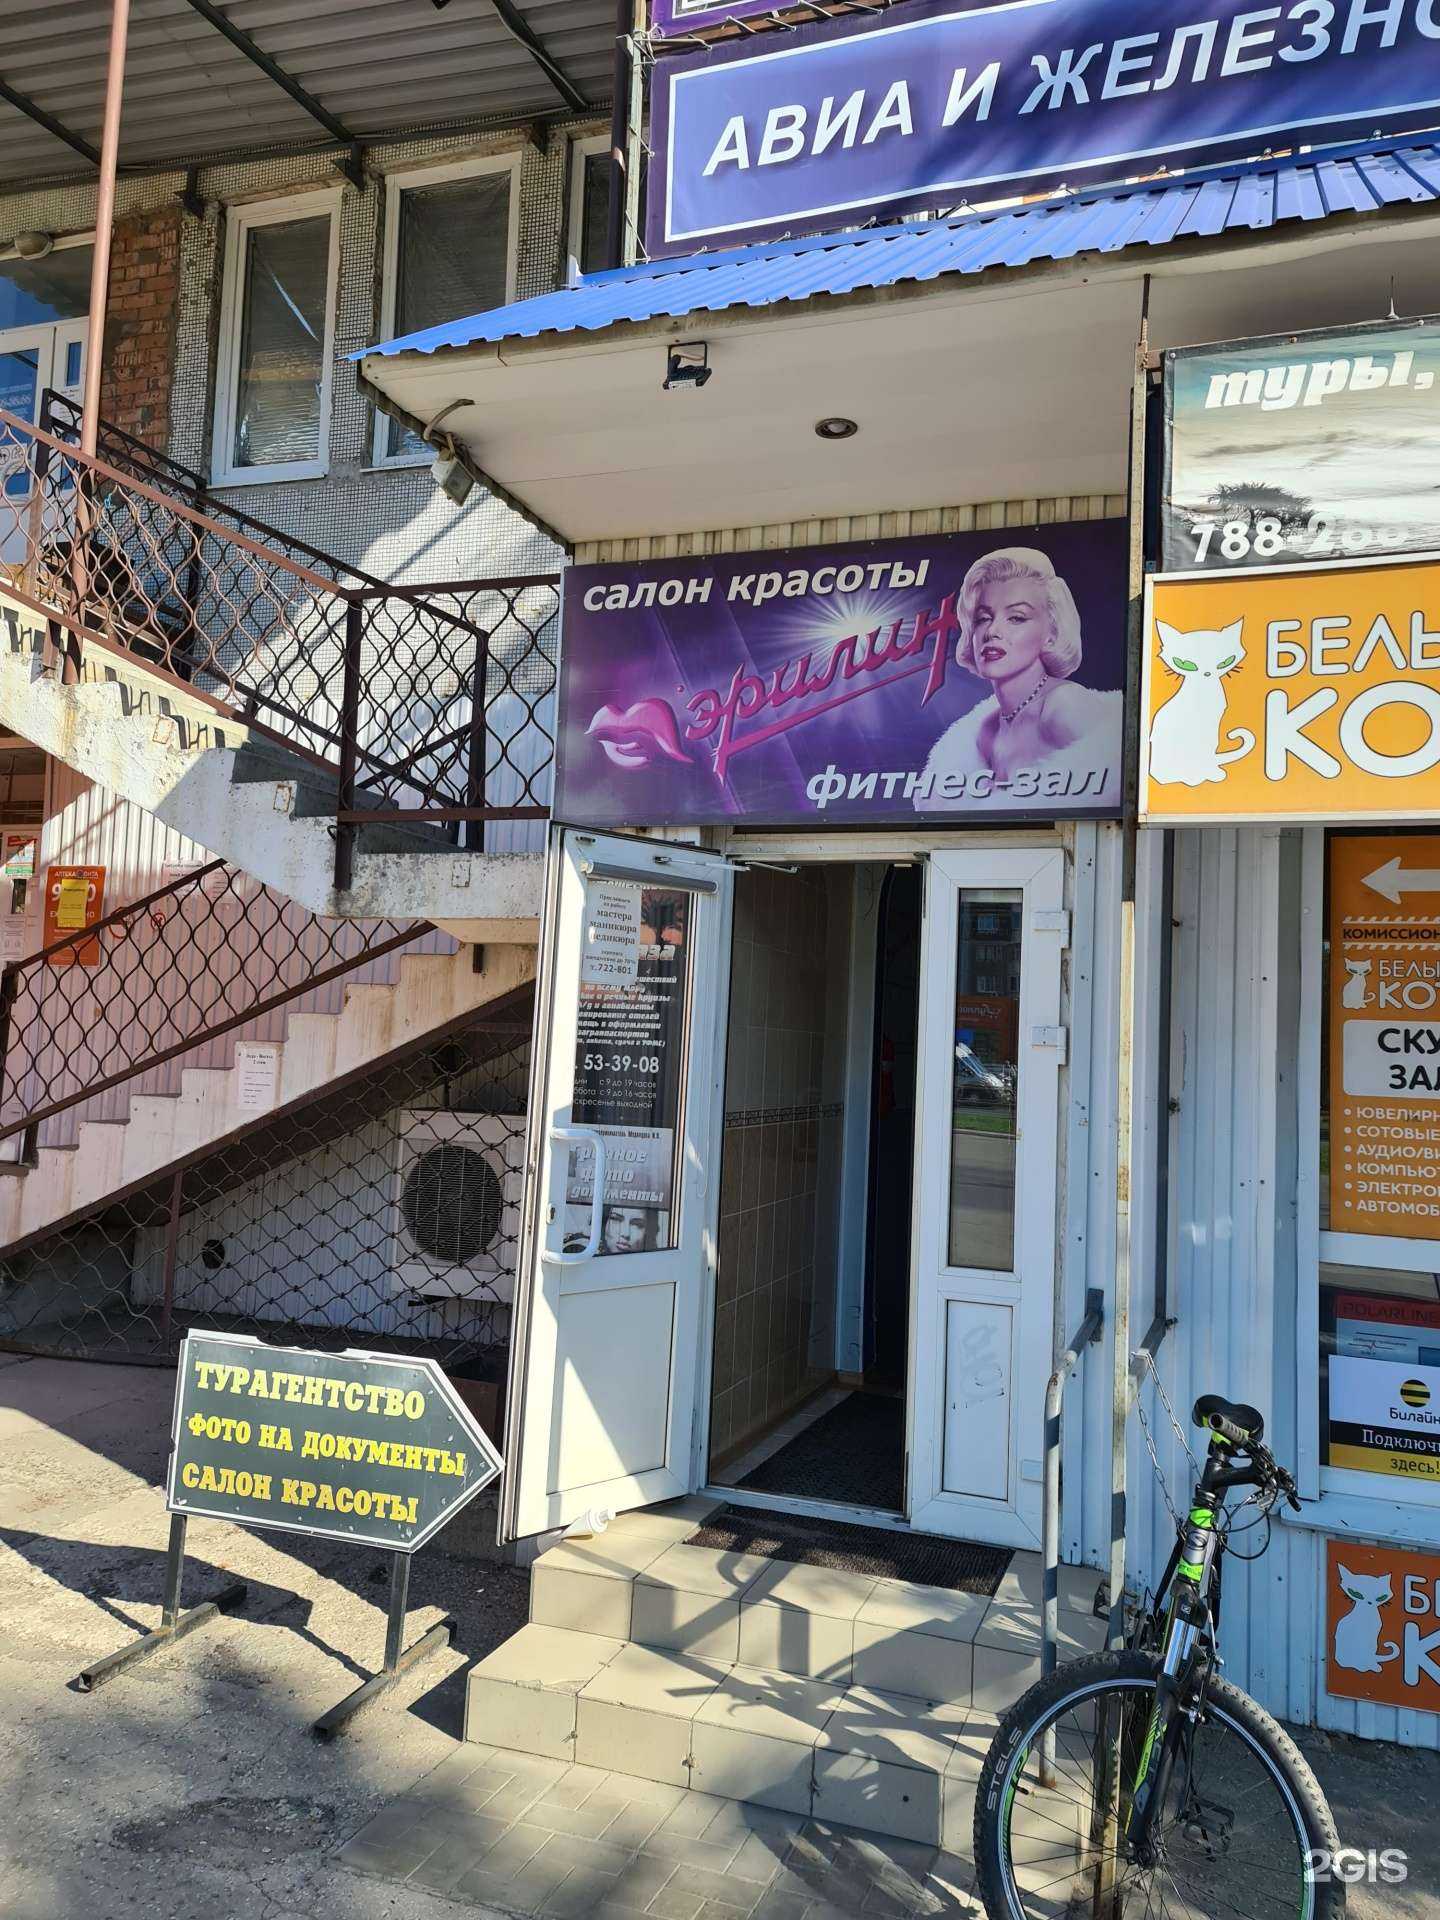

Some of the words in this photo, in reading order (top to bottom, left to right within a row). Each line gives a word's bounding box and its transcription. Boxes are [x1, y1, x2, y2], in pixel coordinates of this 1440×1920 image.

[702, 80, 915, 177] АВИА
[941, 62, 1002, 128] И
[1205, 351, 1434, 411] туры,
[582, 576, 713, 611] салон
[727, 558, 930, 607] красоты
[806, 765, 1109, 808] фитнес-зал
[590, 920, 637, 934] маникюра
[597, 910, 632, 921] мастера
[1379, 981, 1440, 1010] КО
[583, 1053, 660, 1074] 53-39-08
[1389, 1064, 1440, 1091] ЗА
[1357, 1126, 1440, 1140] СОТОВЫЕ
[582, 1167, 634, 1184] фто
[1357, 1181, 1440, 1197] ЭЛЕКТРО
[570, 1186, 664, 1203] доменты
[195, 1361, 426, 1420] ТУРАГЕНТСТВО
[188, 1413, 251, 1445] ФОТО
[258, 1424, 294, 1452] НА
[301, 1431, 467, 1477] ДОКУМЕНТЫ
[1390, 1458, 1440, 1475] здесь!
[182, 1462, 273, 1501] САЛОН
[281, 1478, 420, 1525] КРАСОТЫ
[987, 1725, 1022, 1812] STELS
